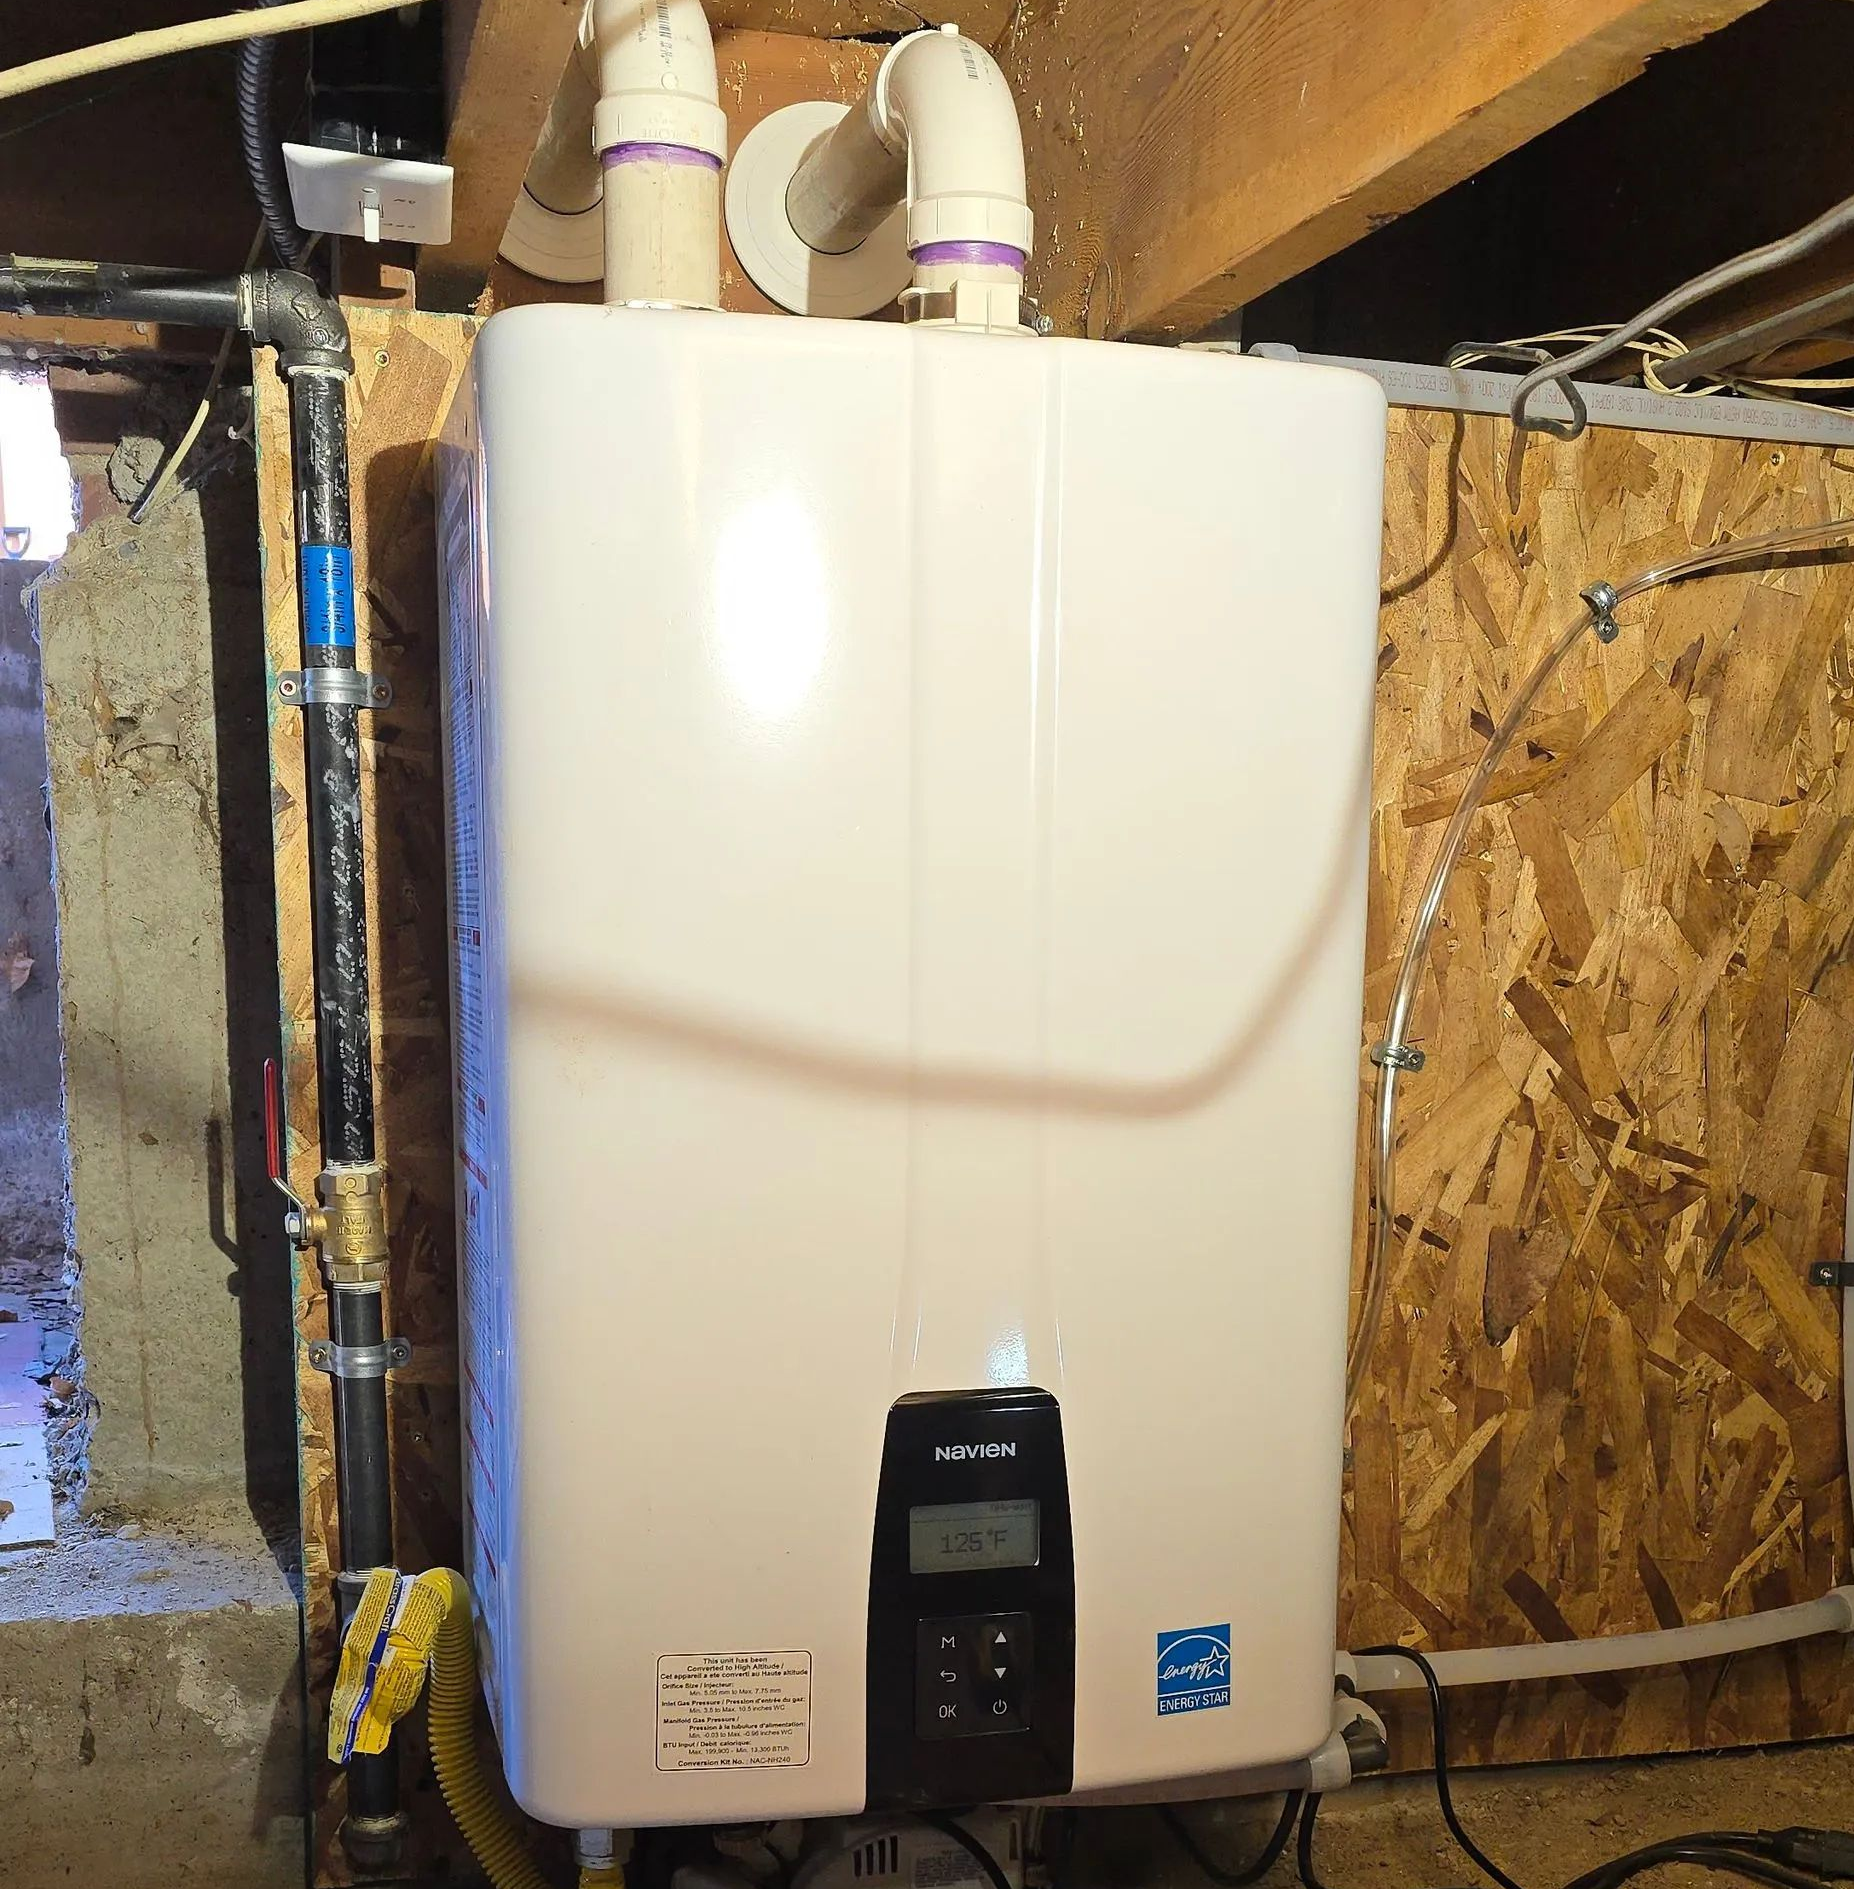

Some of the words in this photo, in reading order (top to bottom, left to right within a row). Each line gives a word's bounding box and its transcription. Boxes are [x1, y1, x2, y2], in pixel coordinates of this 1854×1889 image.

[941, 1635, 956, 1649] M
[735, 1664, 751, 1672] High
[1160, 1695, 1201, 1712] ENERGY
[1202, 1691, 1229, 1706] STAR
[939, 1704, 957, 1719] OK
[677, 1759, 719, 1767] Conversion
